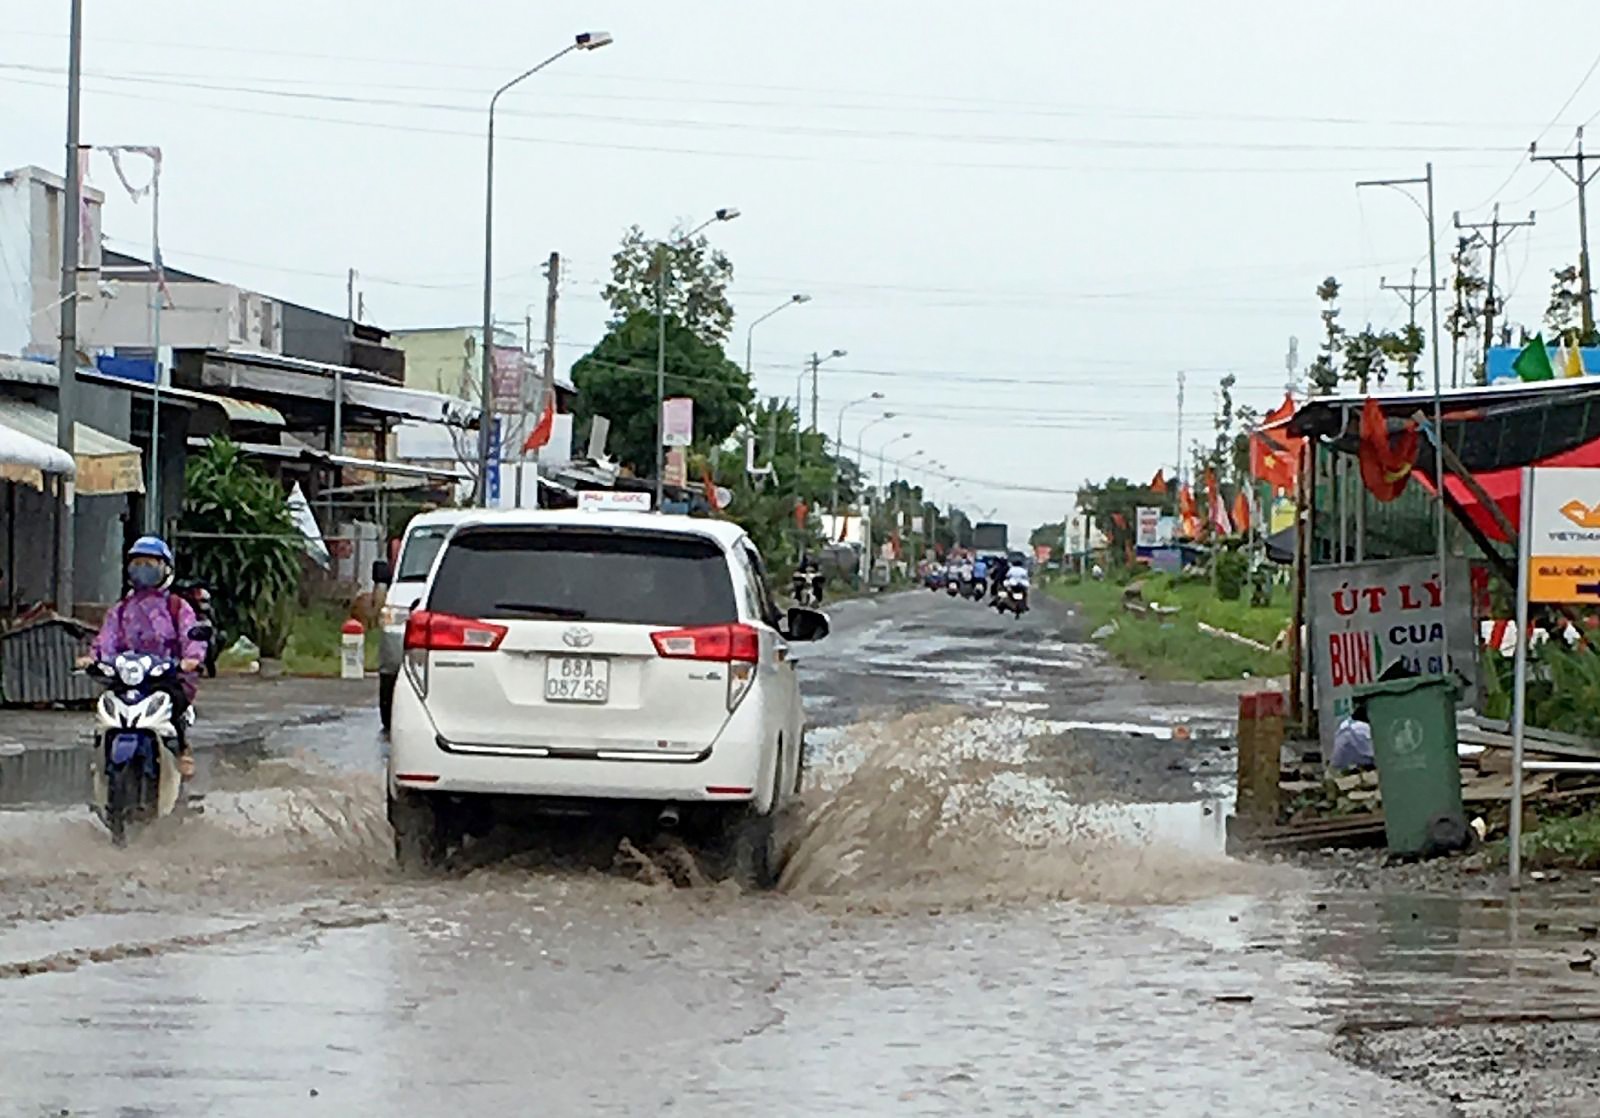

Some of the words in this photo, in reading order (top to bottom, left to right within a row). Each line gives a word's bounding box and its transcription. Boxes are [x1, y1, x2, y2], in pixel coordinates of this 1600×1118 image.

[1332, 582, 1387, 616] ÚT
[1398, 573, 1443, 610] LÝ
[1389, 622, 1443, 645] CUA
[562, 657, 594, 678] 68A
[1329, 619, 1374, 687] BÚN
